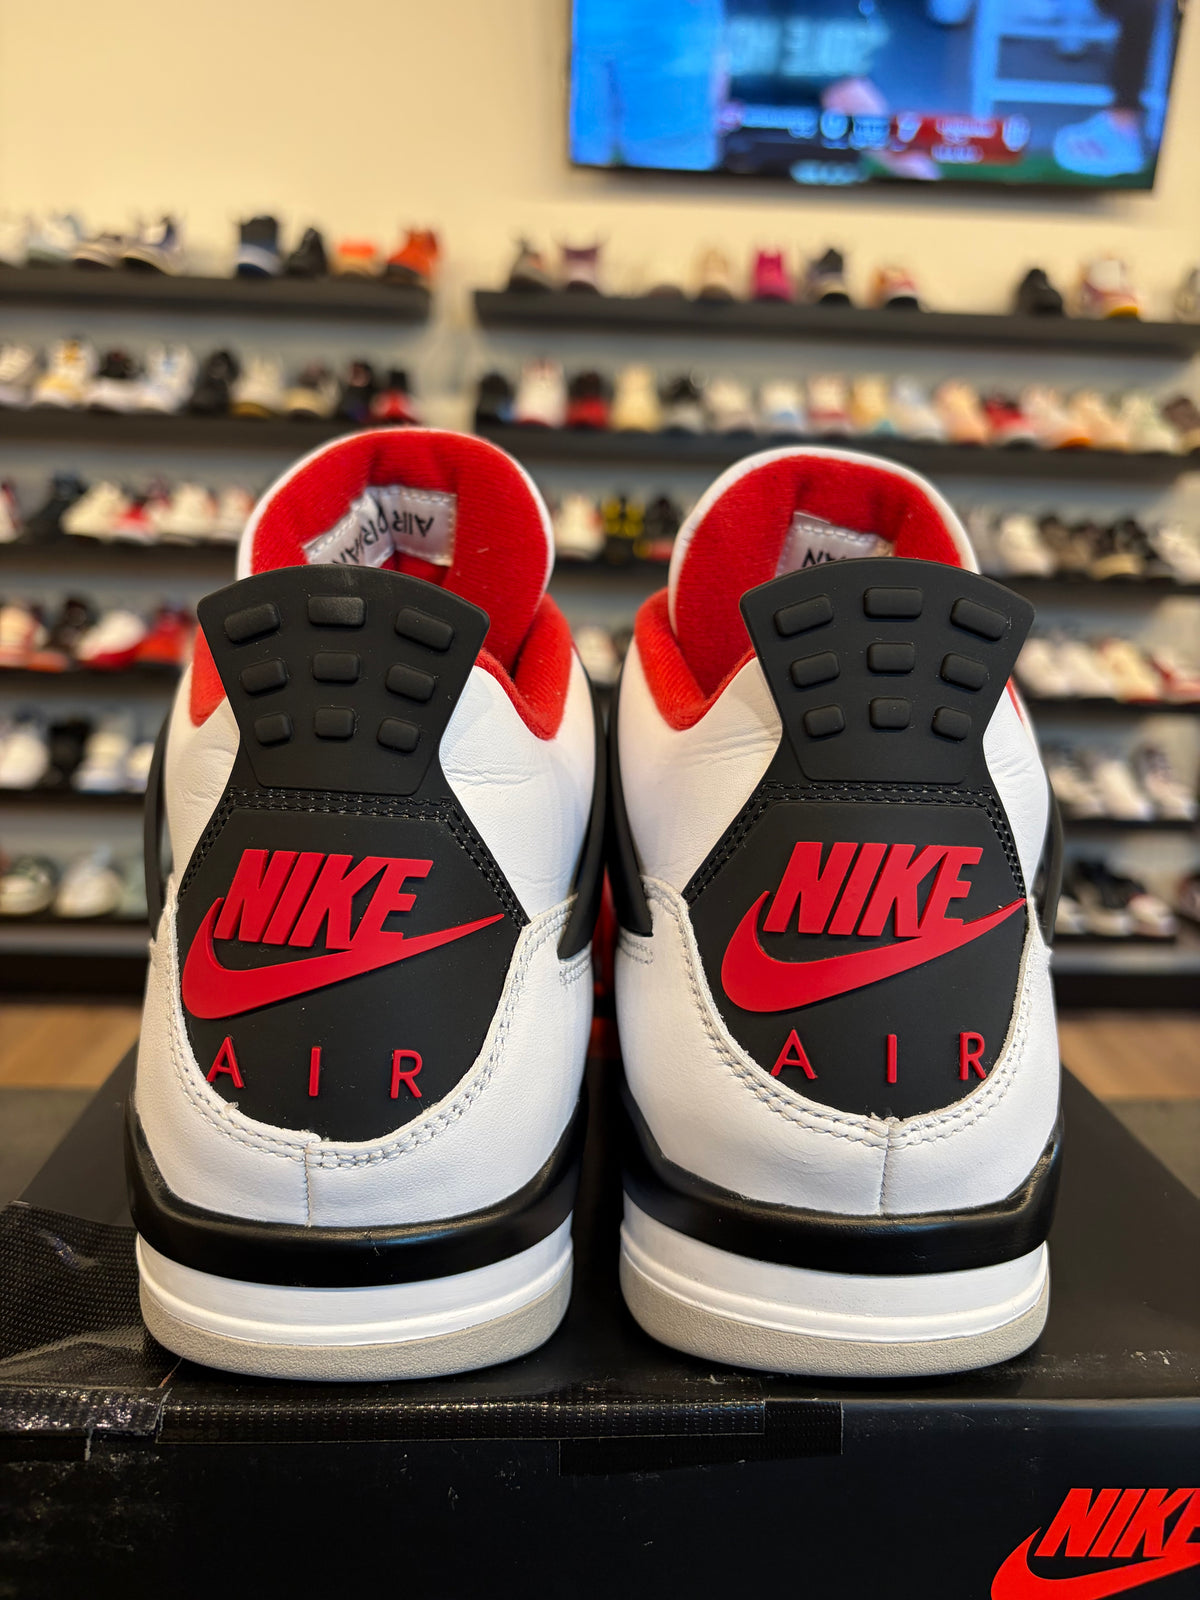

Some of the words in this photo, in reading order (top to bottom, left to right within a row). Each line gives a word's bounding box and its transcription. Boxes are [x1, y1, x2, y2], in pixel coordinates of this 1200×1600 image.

[392, 509, 435, 537] AIR
[212, 848, 434, 950] NIKE
[763, 841, 984, 939] NIKE
[205, 1036, 423, 1099] AIR
[770, 1028, 987, 1083] AIR
